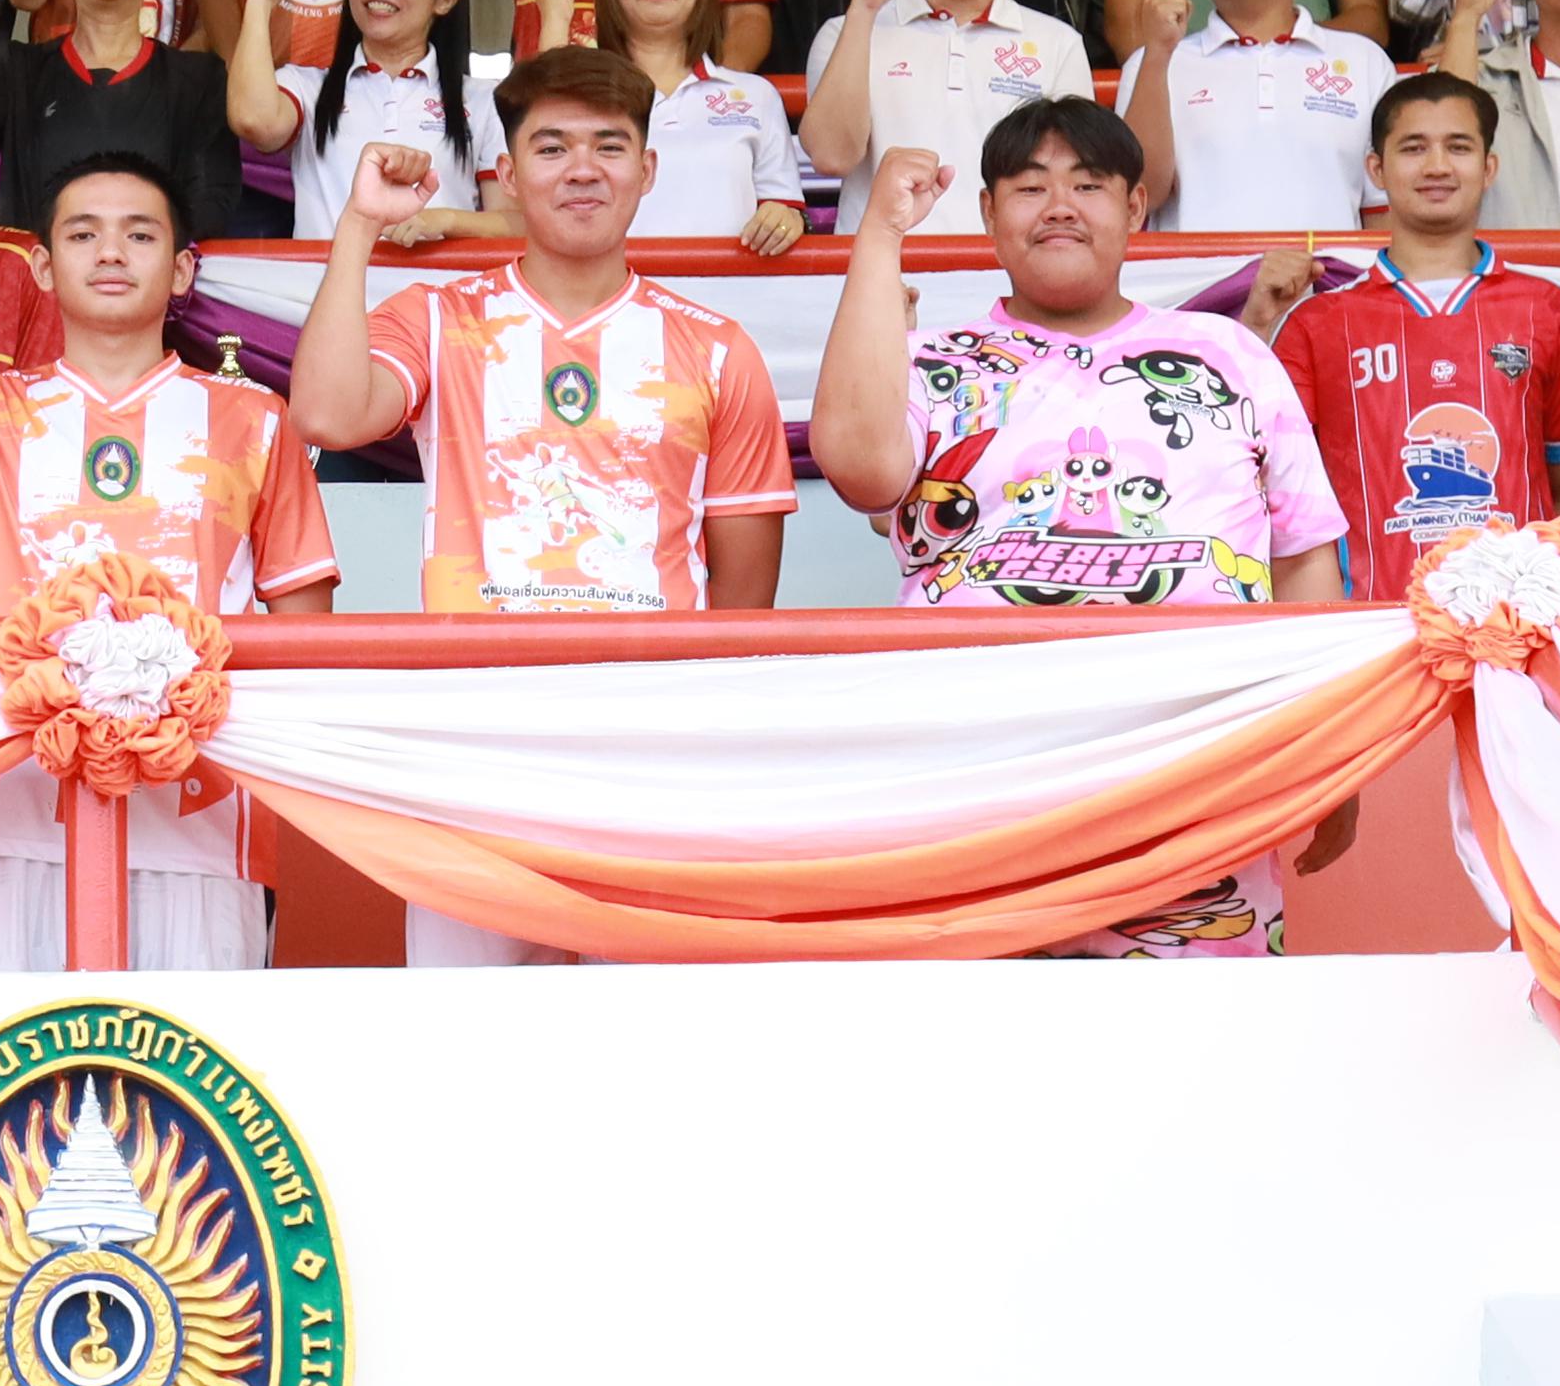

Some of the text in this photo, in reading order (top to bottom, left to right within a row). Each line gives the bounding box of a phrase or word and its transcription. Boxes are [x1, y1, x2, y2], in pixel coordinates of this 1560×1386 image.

[279, 0, 323, 18] MPHAENG
[1351, 343, 1398, 389] 30
[1412, 514, 1456, 527] MONEY
[975, 539, 1207, 564] POWERPUFF
[995, 559, 1146, 587] GIRLS
[636, 593, 665, 609] 2568
